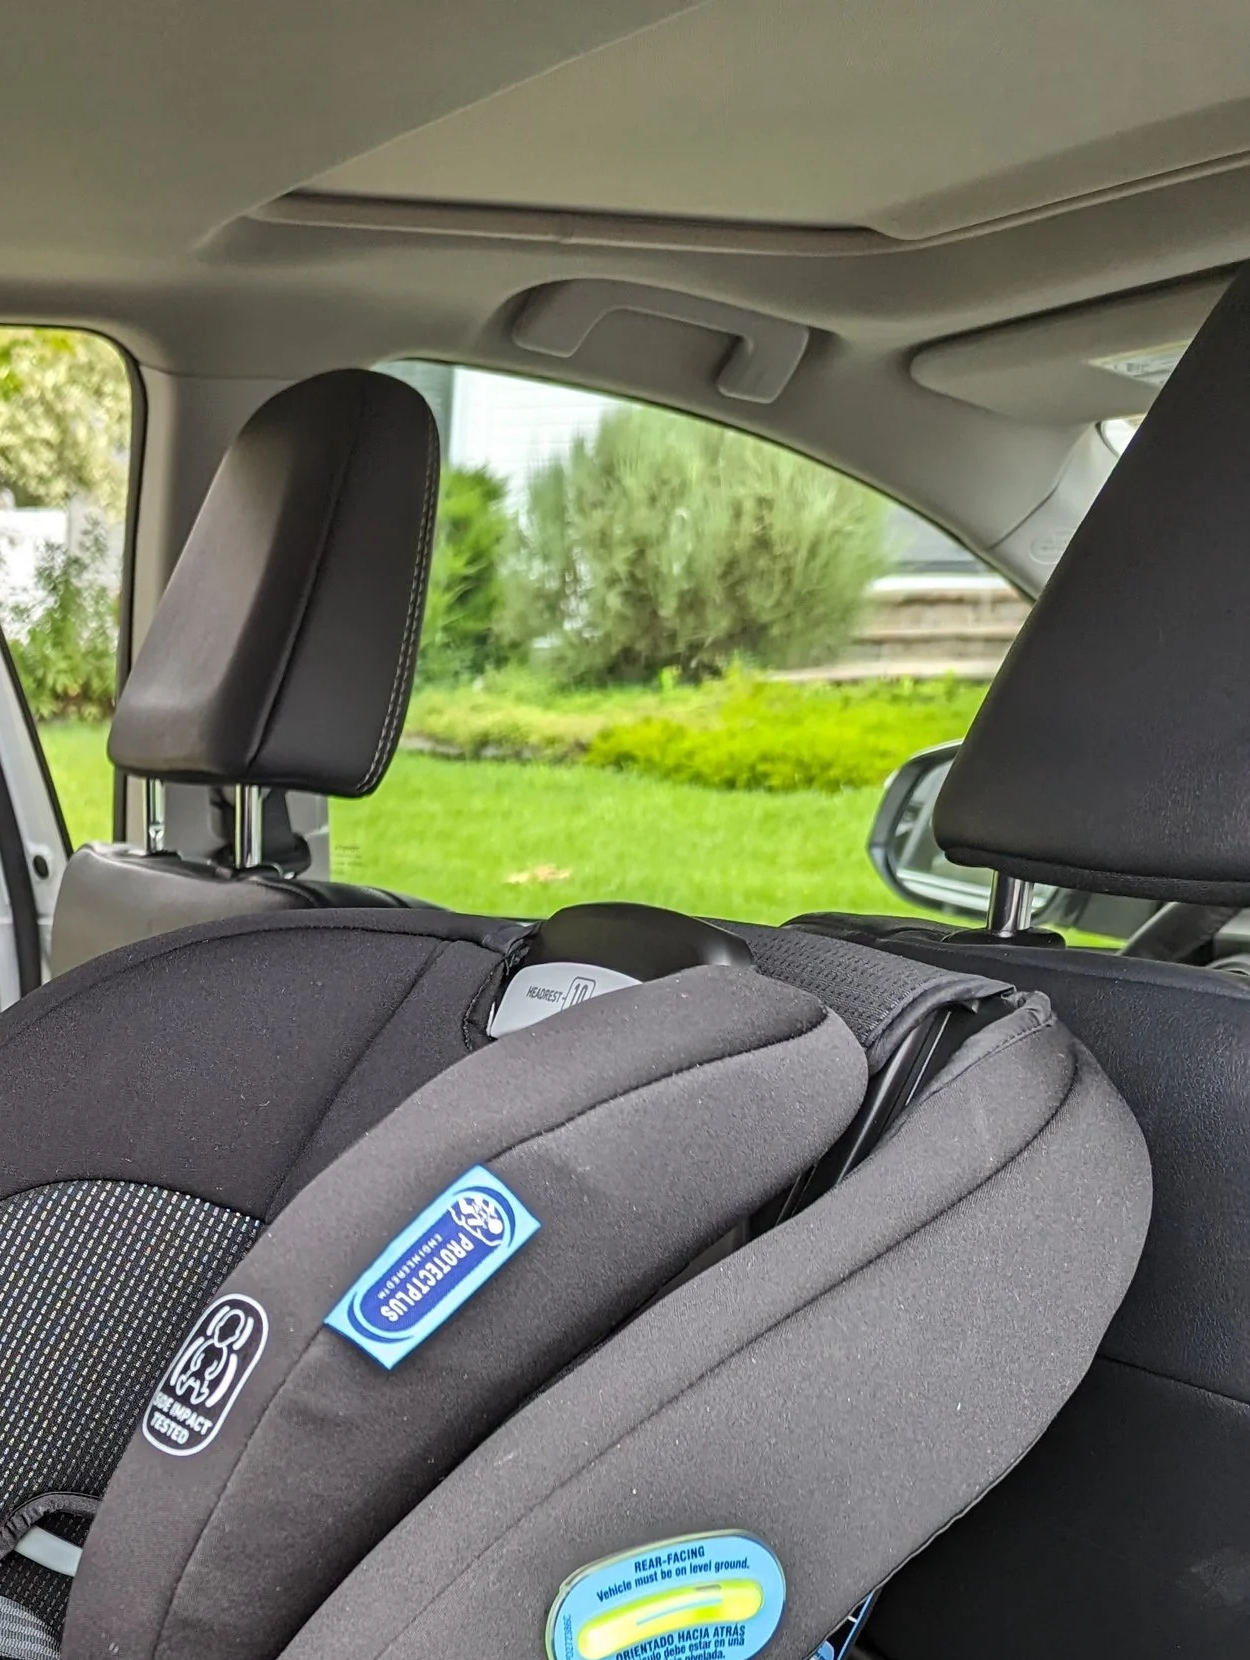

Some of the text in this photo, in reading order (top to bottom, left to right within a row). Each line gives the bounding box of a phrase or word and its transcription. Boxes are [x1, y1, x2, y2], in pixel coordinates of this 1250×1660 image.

[380, 1232, 474, 1321] PROTECTPLUS
[150, 1411, 189, 1444] TESTED
[169, 1401, 213, 1435] IMPACT
[634, 1546, 705, 1573] REAR-FACING
[597, 1579, 632, 1602] Vehicle
[635, 1572, 658, 1587] must
[661, 1570, 672, 1580] be
[690, 1559, 711, 1574] level
[715, 1558, 750, 1573] ground.
[678, 1628, 710, 1643] HACIA
[713, 1623, 746, 1639] ATRÁS
[689, 1641, 711, 1655] estar
[714, 1638, 725, 1648] en
